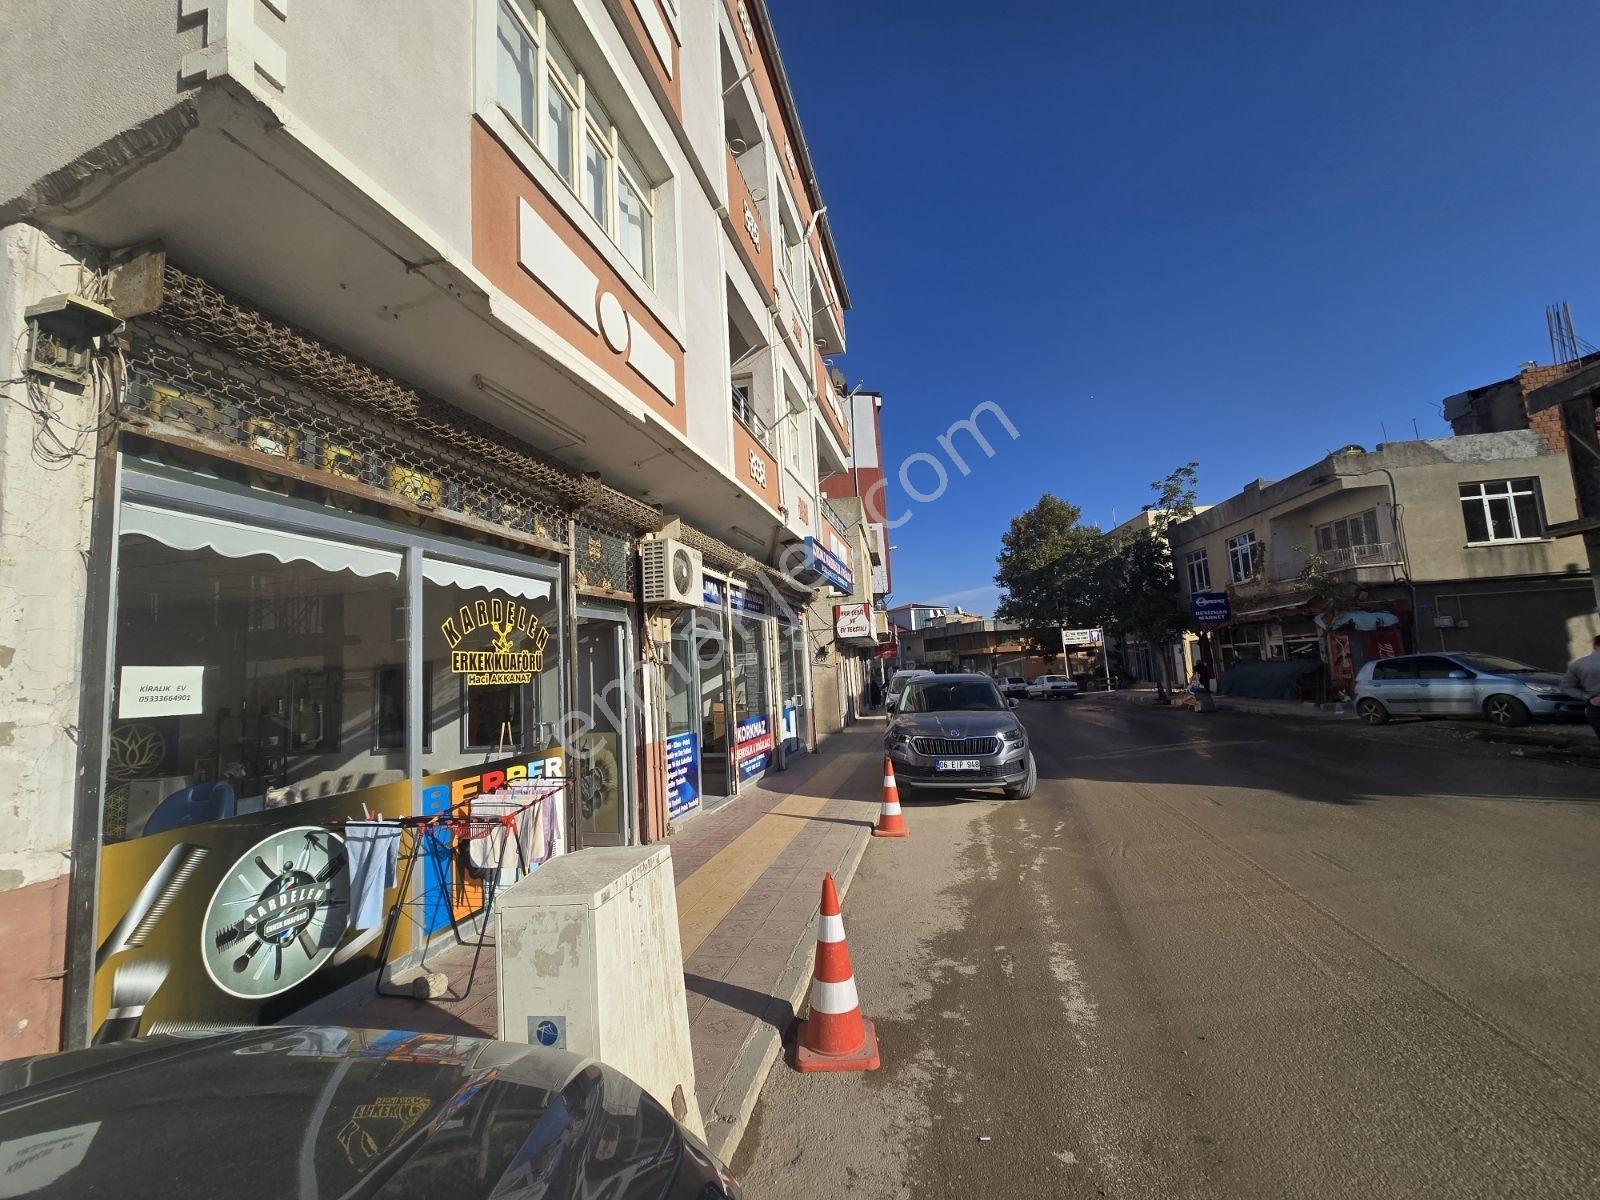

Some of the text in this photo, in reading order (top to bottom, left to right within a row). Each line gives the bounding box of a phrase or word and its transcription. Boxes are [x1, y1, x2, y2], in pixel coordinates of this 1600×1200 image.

[441, 598, 550, 650] KARDELEN
[452, 651, 493, 673] ERKEK
[139, 685, 172, 693] KİRALIK
[491, 672, 532, 684] AKKANAT
[737, 720, 767, 743] KORKMAZ
[246, 888, 323, 925] KARDELEN
